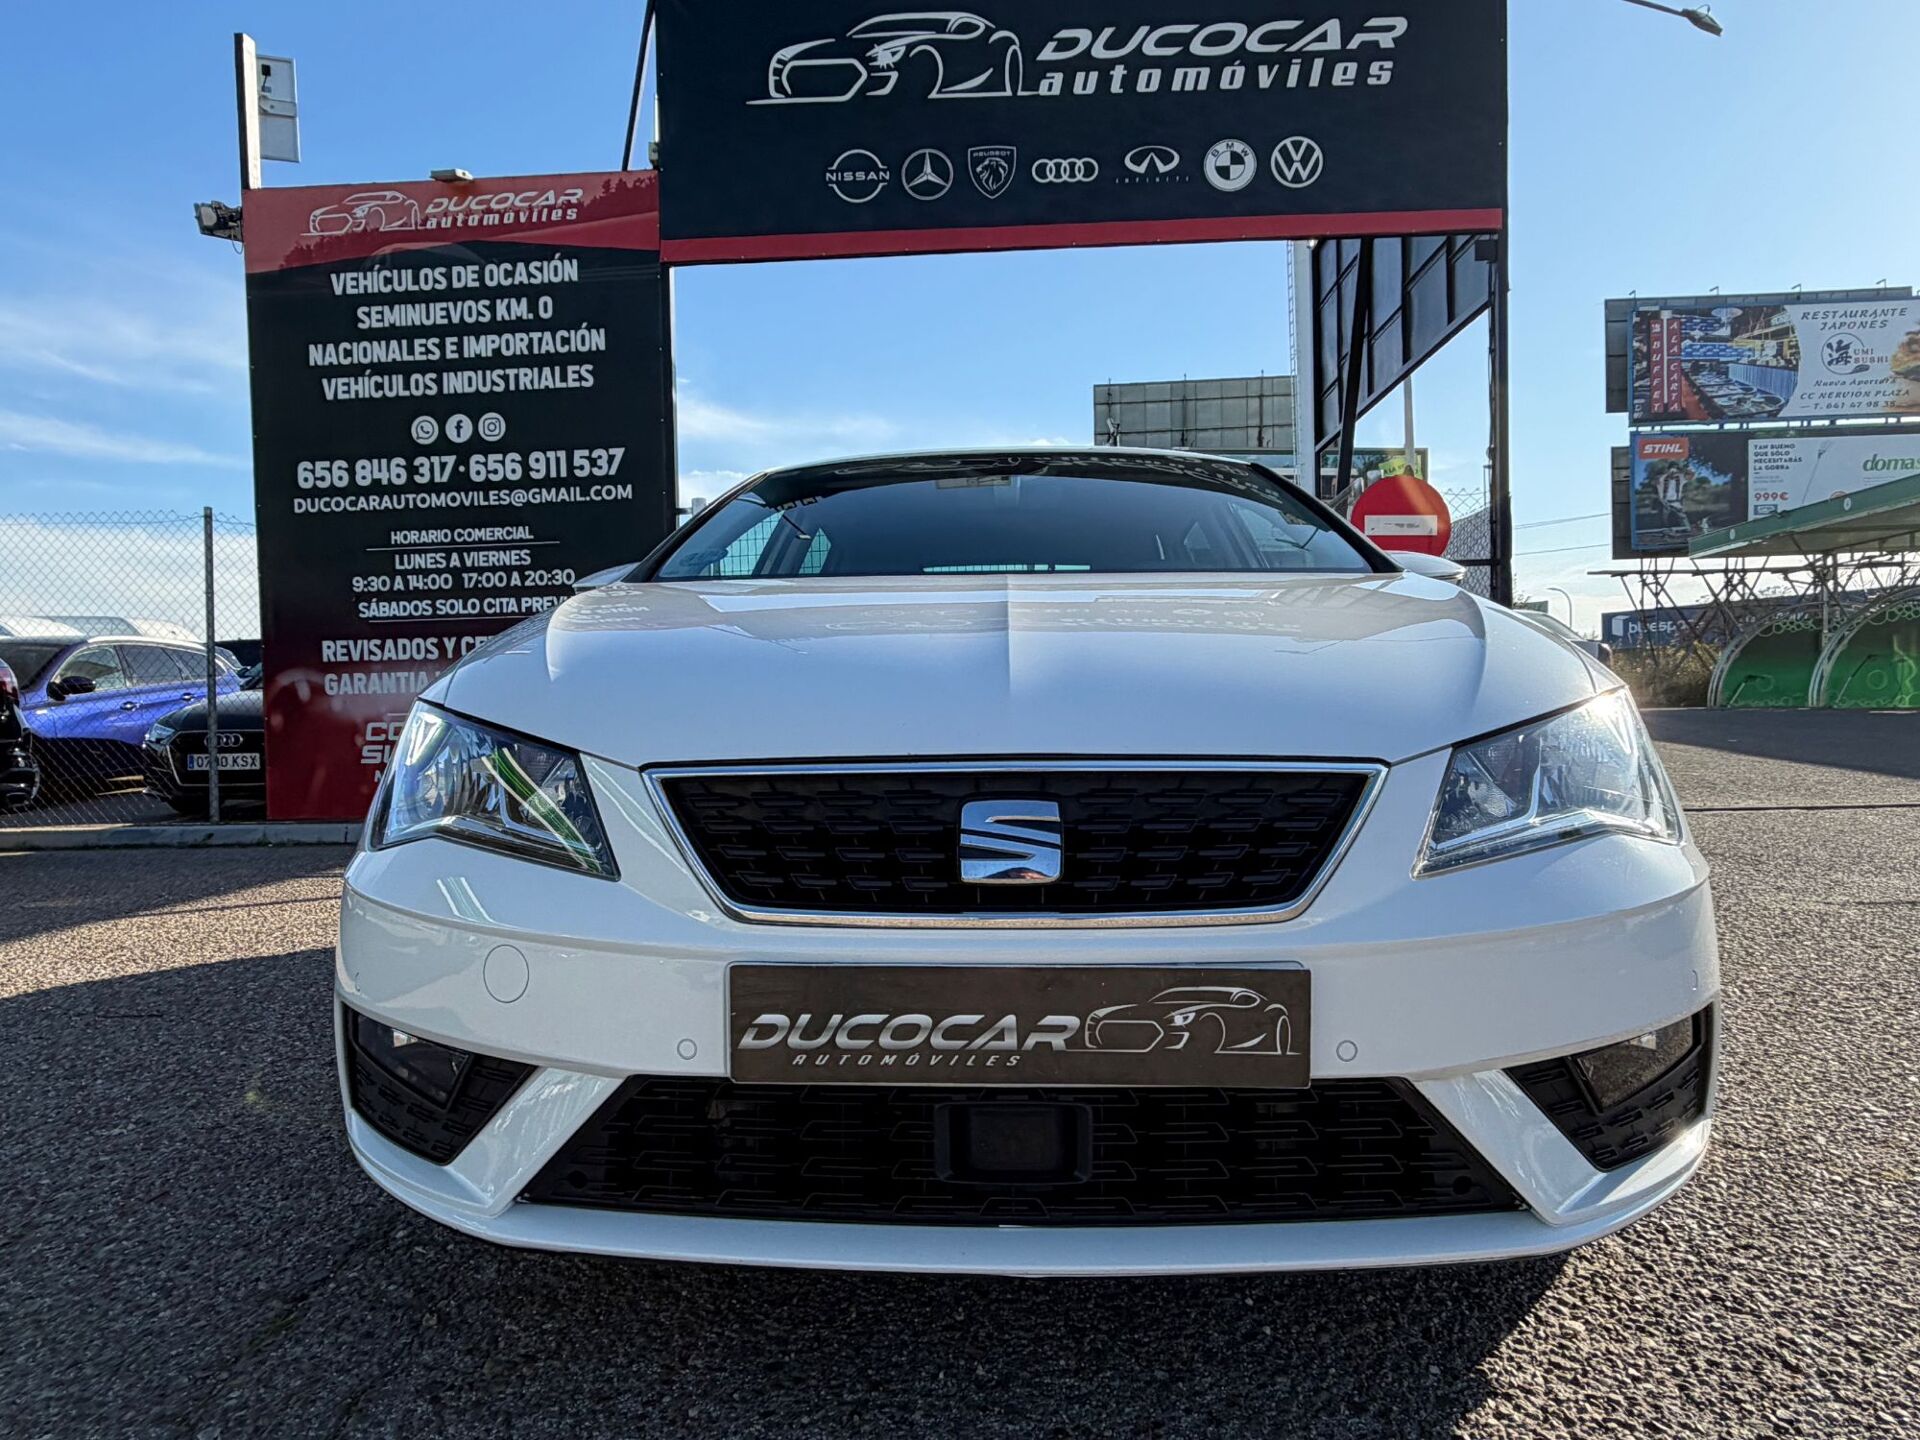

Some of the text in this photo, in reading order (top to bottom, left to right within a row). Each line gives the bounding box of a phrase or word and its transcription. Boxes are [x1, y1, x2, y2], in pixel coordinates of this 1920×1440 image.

[1036, 17, 1408, 61] DUCOCAR
[1039, 57, 1394, 96] automóviles
[825, 170, 890, 182] NISSAN
[426, 188, 583, 214] DUCOCAR
[426, 207, 578, 230] automóviles
[331, 252, 578, 296] VEHÍCULOS DE OCASIÓN
[356, 300, 491, 329] SEMINUEVOS
[496, 299, 534, 322] KM.
[1801, 308, 1908, 320] RESTAURANTE
[308, 322, 606, 367] NACIONALES E IMPORTACIÓN
[1854, 356, 1889, 364] SUSHI
[321, 364, 595, 401] VEHÍCULOS INDUSTRIALES
[1800, 392, 1815, 400] CC
[1874, 389, 1910, 398] PLAZA
[1643, 443, 1683, 454] STIHL
[297, 460, 350, 489] 656
[355, 456, 408, 487] 846
[469, 453, 522, 483] 656
[528, 450, 568, 479] 911
[573, 447, 626, 477] 537
[294, 484, 633, 514] DUCOCARAUTOMOVILES@GMAIL.COM
[1754, 491, 1789, 502] 999€
[391, 526, 535, 545] HORARIO COMERCIAL
[395, 549, 532, 570] LUNES A VIERNES
[352, 568, 576, 593] 9:30 A 14:00 17:00 A 20:30
[358, 597, 433, 618] SÁBADOS
[435, 598, 480, 615] SOLO
[483, 597, 519, 613] CITA
[322, 637, 439, 663] REVISADOS
[442, 636, 457, 659] Y
[233, 755, 257, 767] KSX
[738, 1013, 1080, 1051] DUCOCAR
[792, 1053, 1022, 1067] AUTOMÓVILES
